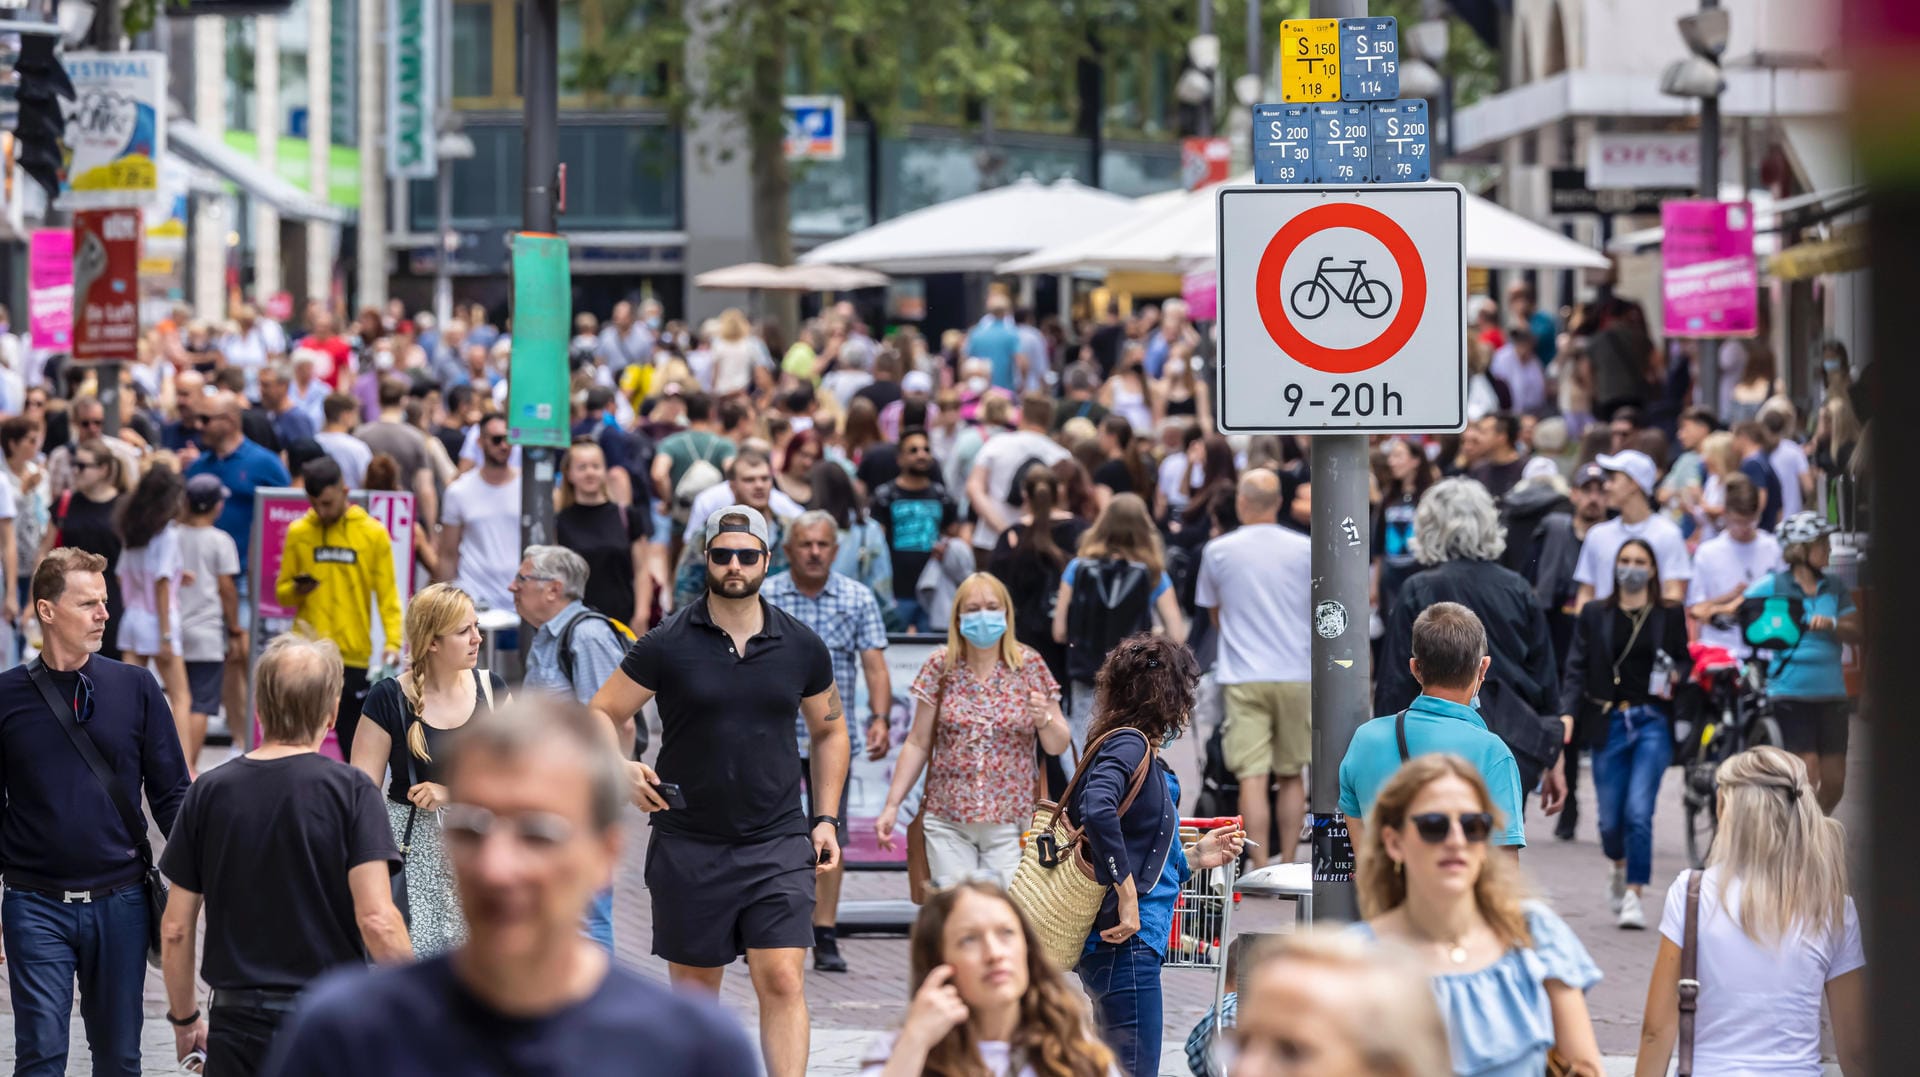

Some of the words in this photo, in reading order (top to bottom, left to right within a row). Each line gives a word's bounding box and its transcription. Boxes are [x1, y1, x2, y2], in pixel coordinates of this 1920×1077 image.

[1298, 36, 1309, 55] S
[1315, 43, 1336, 55] 150
[1356, 35, 1368, 54] S
[1373, 41, 1395, 53] 150
[65, 61, 149, 78] ESTIVAL
[1271, 121, 1282, 140] S
[1286, 127, 1309, 140] 200
[1329, 119, 1341, 138] S
[1344, 125, 1367, 138] 200
[1387, 117, 1399, 136] S
[1403, 123, 1425, 136] 200
[1327, 828, 1348, 837] 11.0
